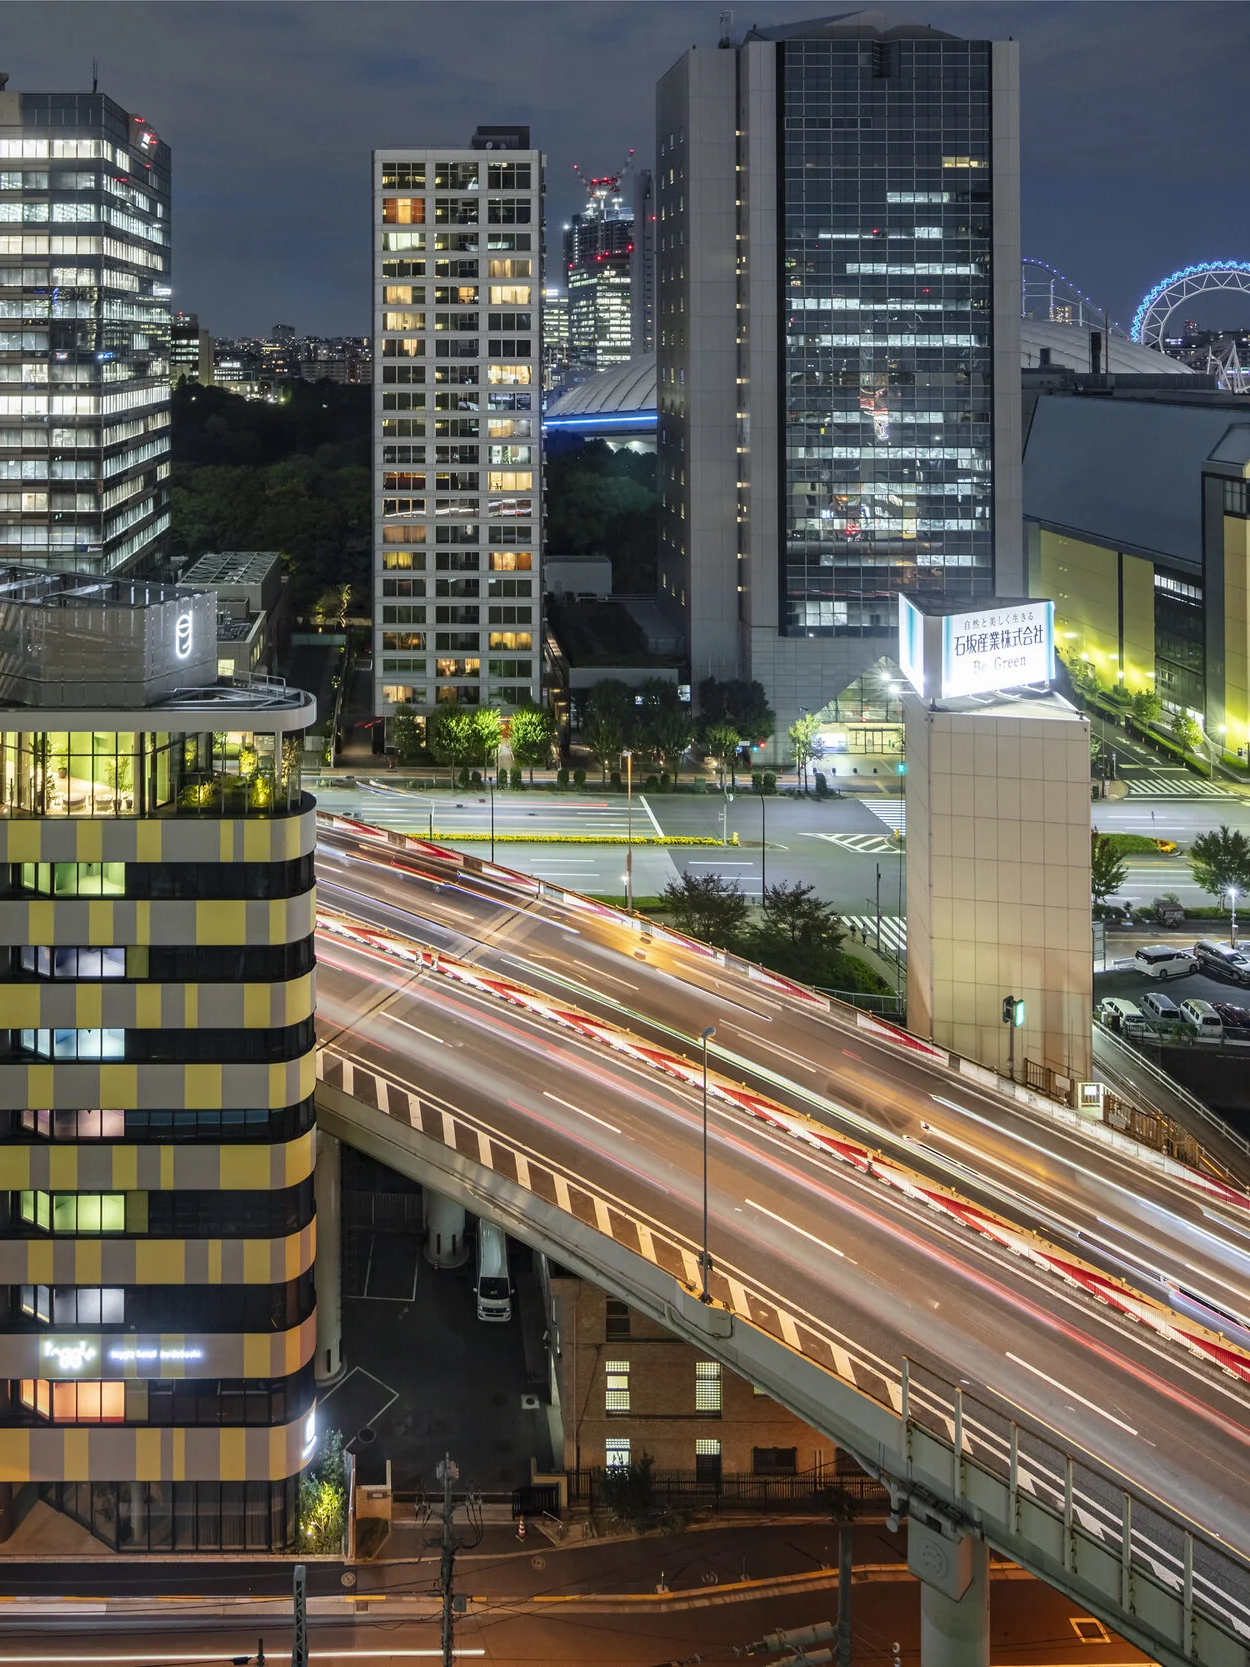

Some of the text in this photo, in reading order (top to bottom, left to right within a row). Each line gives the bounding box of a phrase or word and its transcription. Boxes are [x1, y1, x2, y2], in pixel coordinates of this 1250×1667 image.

[964, 612, 1034, 631] 自然と美しく生きる
[954, 624, 1044, 656] 石坂産業株式会社
[973, 656, 1026, 674] Be Green
